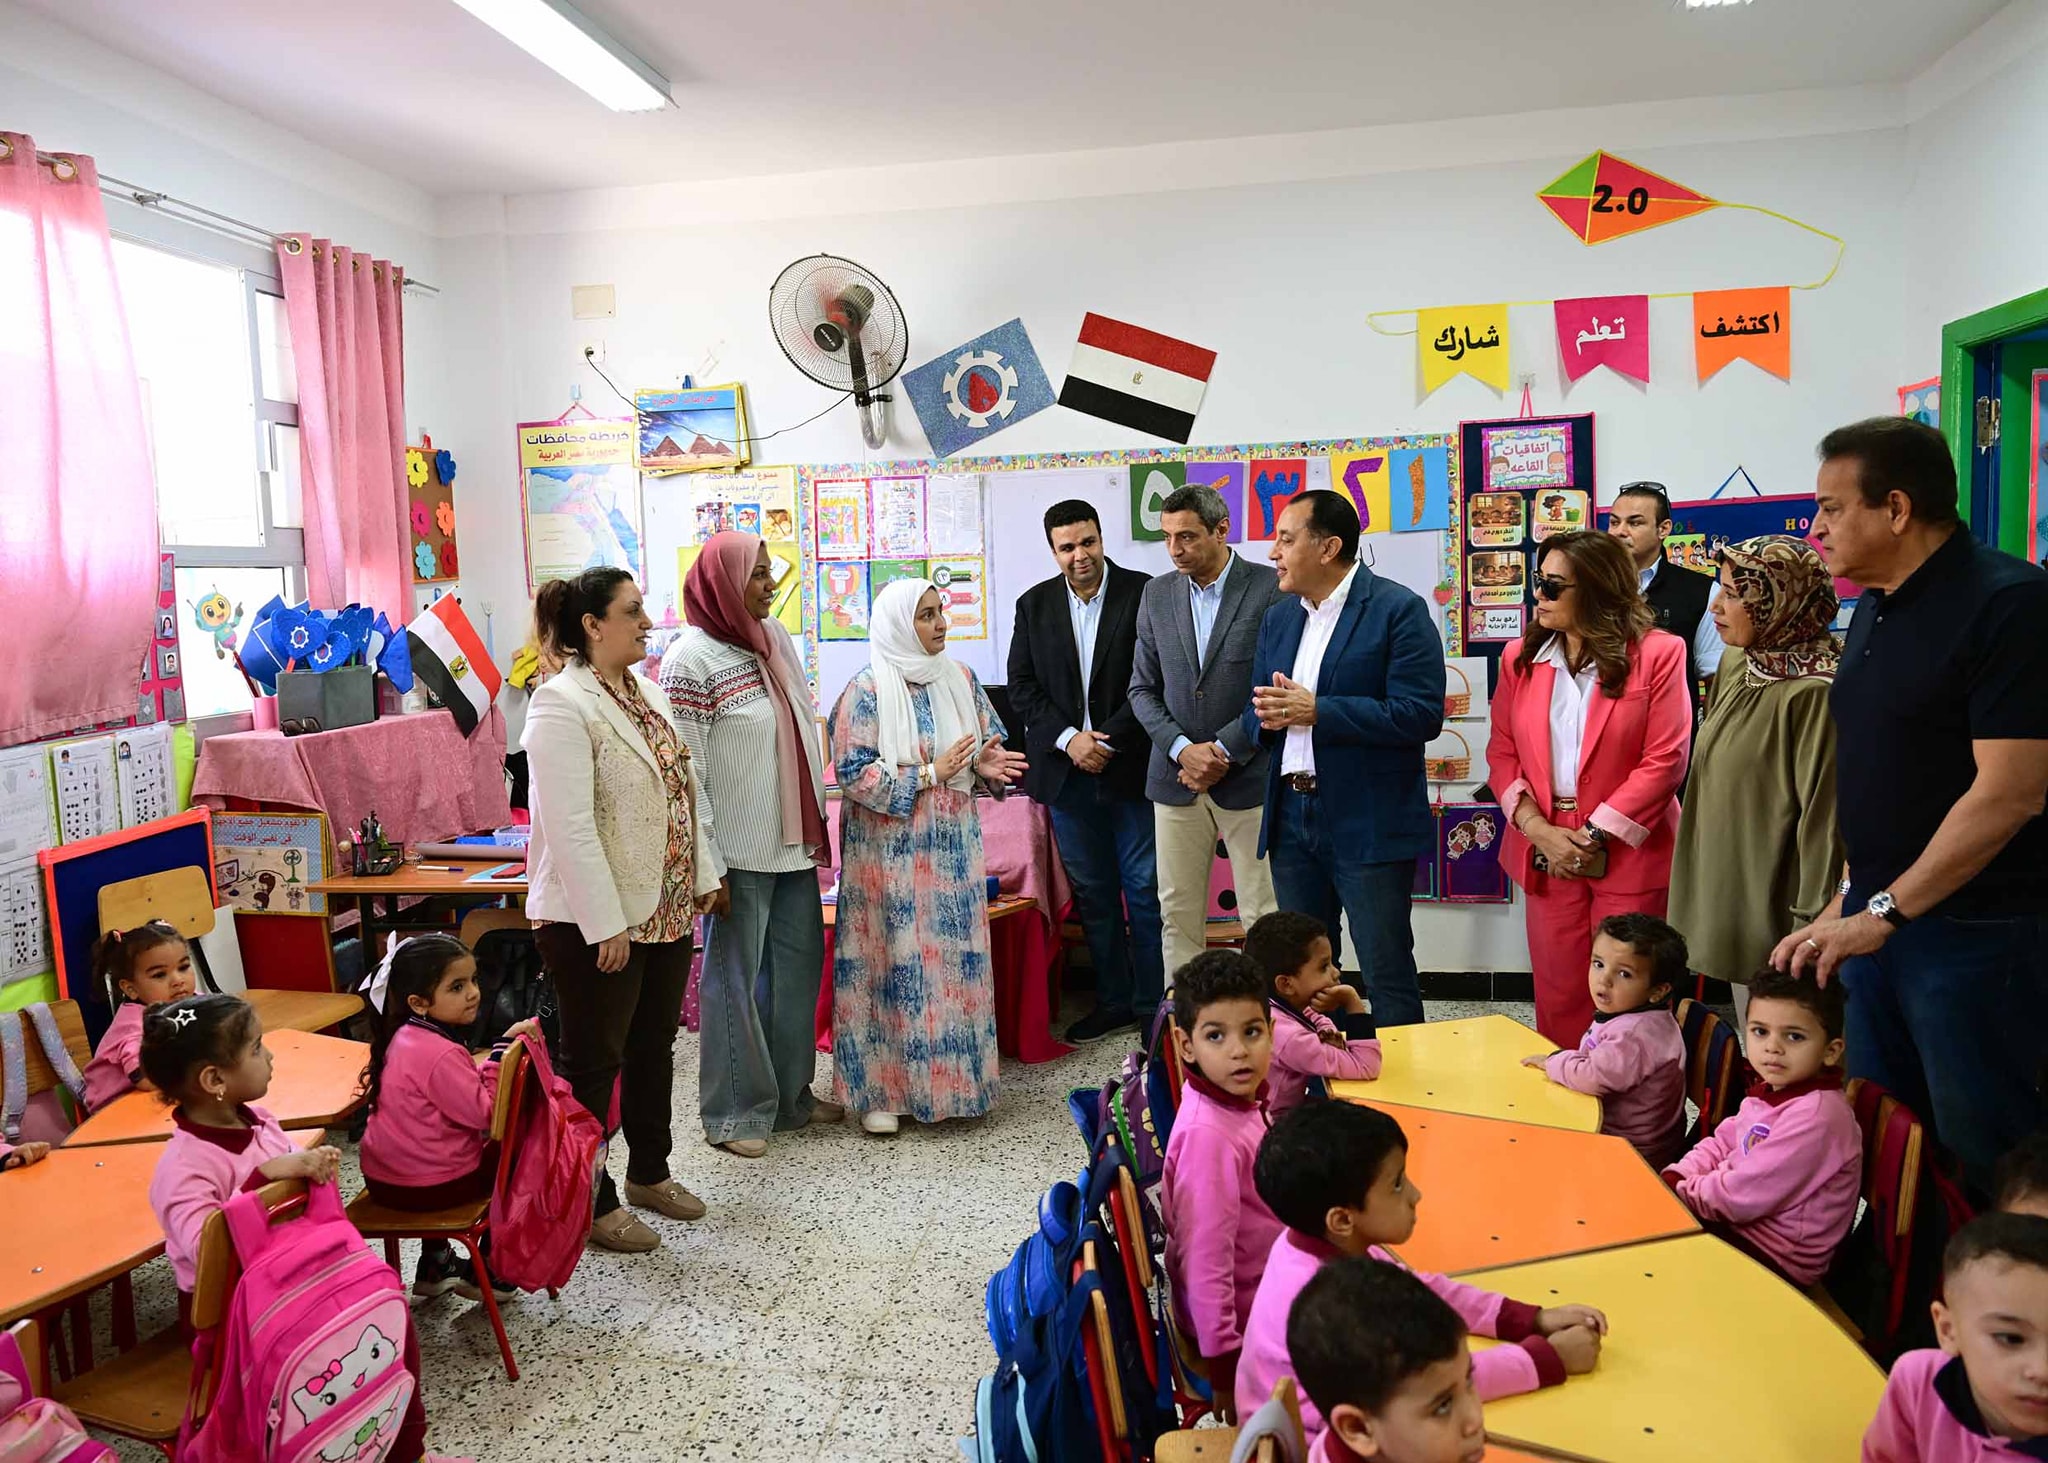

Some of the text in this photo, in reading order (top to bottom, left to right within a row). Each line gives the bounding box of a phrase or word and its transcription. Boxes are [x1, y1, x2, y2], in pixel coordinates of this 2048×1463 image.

[1591, 183, 1649, 216] 2.0
[1575, 315, 1627, 355] تعلم
[1699, 310, 1780, 339] اكتشف
[1433, 323, 1500, 361] شارك
[526, 431, 586, 445] محافظات
[537, 448, 566, 461] العربية
[1502, 441, 1550, 457] اتفاقيات
[1253, 468, 1301, 538] ٣
[1341, 456, 1385, 533] ٢
